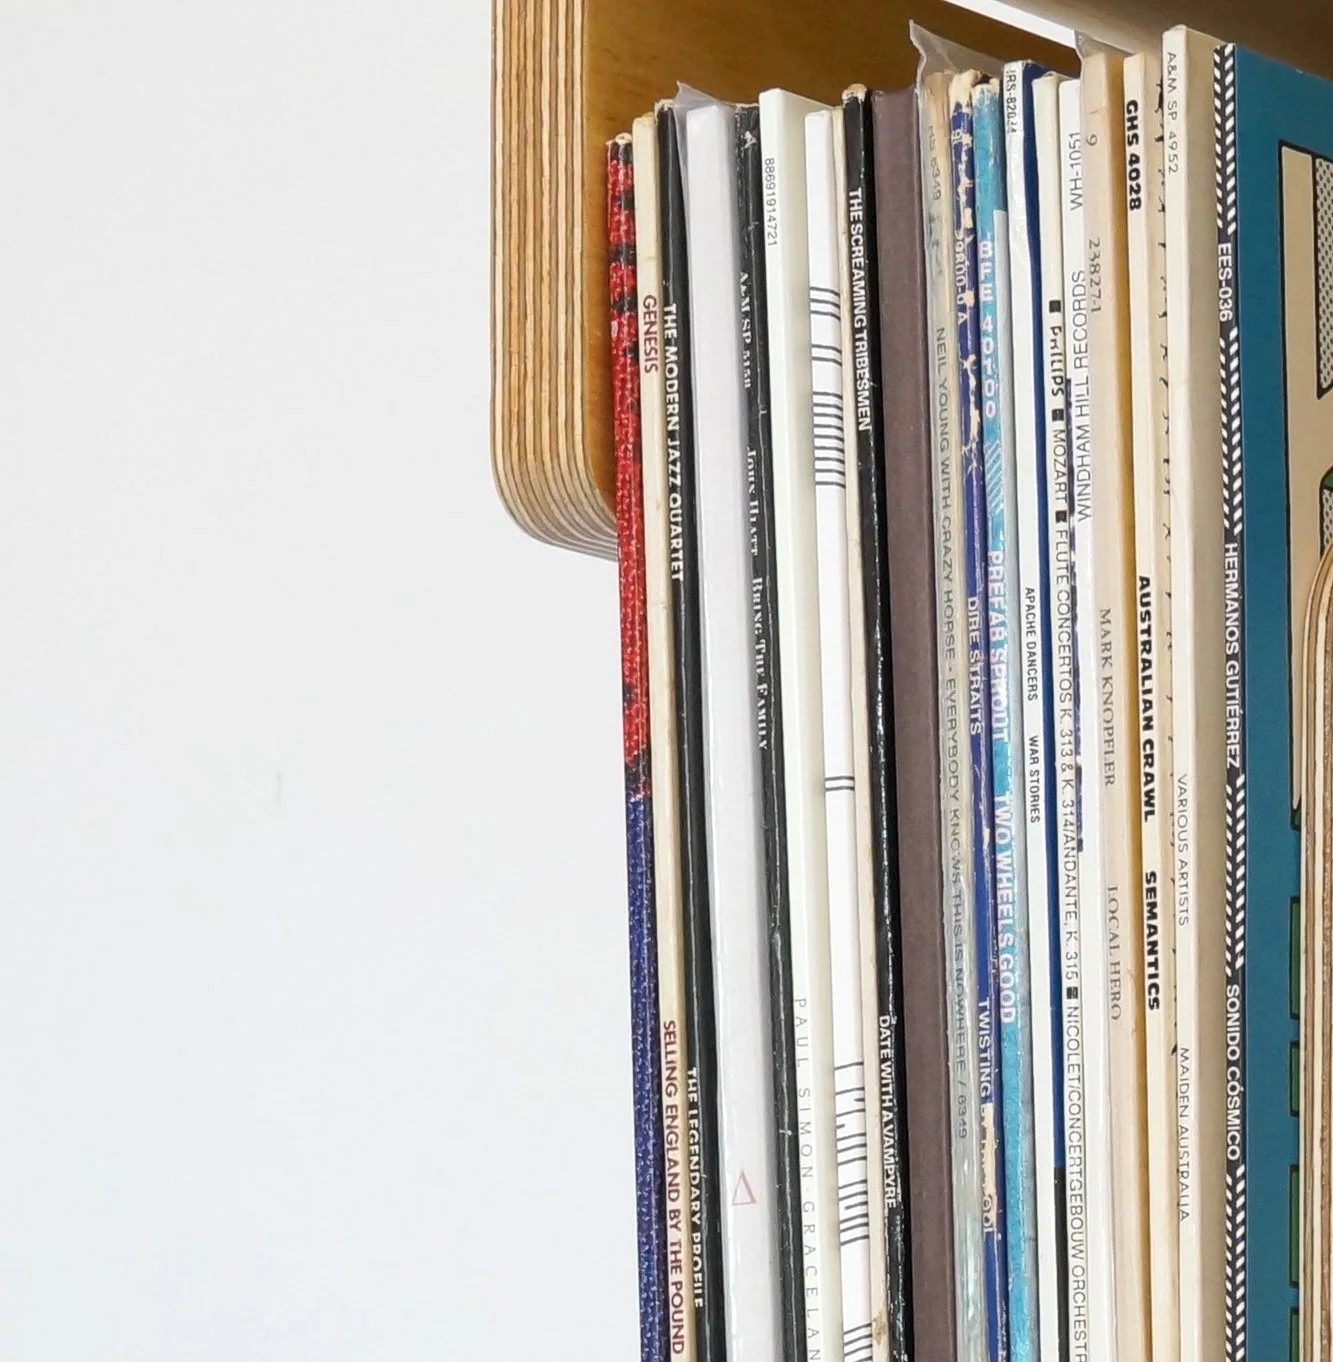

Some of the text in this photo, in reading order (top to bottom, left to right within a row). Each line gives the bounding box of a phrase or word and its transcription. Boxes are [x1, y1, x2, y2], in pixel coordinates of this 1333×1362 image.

[1126, 99, 1142, 211] GHS 4028
[1166, 51, 1179, 174] A&M 4952
[763, 157, 778, 247] 88691914721
[1068, 131, 1083, 211] WH-1051
[848, 187, 872, 431] THE SCREAMING TRIBESMEN
[1089, 238, 1103, 314] 23827-1
[1218, 242, 1232, 322] EES-036
[642, 294, 659, 374] GENESIS
[936, 327, 950, 374] NEIL
[937, 376, 951, 452] YOUNG
[1072, 270, 1091, 522] WINDHAM HILL RECORDS
[663, 303, 684, 581] THE MODERN JAZZ QUARTET
[939, 456, 953, 511] WITH
[1052, 429, 1068, 504] MOZART
[941, 517, 955, 585] CRAZY
[1056, 529, 1070, 585] FLUTE
[942, 590, 956, 658] HORSE
[988, 553, 1009, 743] PREFAB SPROUT
[1025, 587, 1038, 701] APACHE DANCERS
[1057, 590, 1072, 704] CONCERTOS
[1224, 544, 1243, 768] HERMANOS GUTIÉRREZ
[945, 678, 961, 802] EVERYBODY
[1099, 608, 1116, 787] MARK KNOPFLER
[1138, 575, 1158, 822] AUSTRALIAN CRAWL
[1028, 735, 1041, 823] WAR STORIES
[1059, 729, 1073, 758] 313
[1060, 762, 1074, 774] &
[1177, 774, 1189, 926] VARIOUS ARTISTS
[952, 890, 965, 935] THIS
[953, 940, 965, 962] IS
[993, 793, 1016, 1024] TWO WHEELS GOOD
[1107, 885, 1122, 1020] LOCAL HERO
[1144, 871, 1161, 1011] SEMANTICS
[1064, 951, 1079, 981] 315
[793, 997, 809, 1069] PAUL
[1226, 984, 1243, 1161] SONIDO CÓSMICO
[878, 1016, 897, 1209] DATE WITH A VAMPYRE
[1178, 1047, 1190, 1119] MAIDEN
[797, 1087, 813, 1179] SIMON
[661, 1019, 686, 1354] SELLING ENGLAND BY THE POUND
